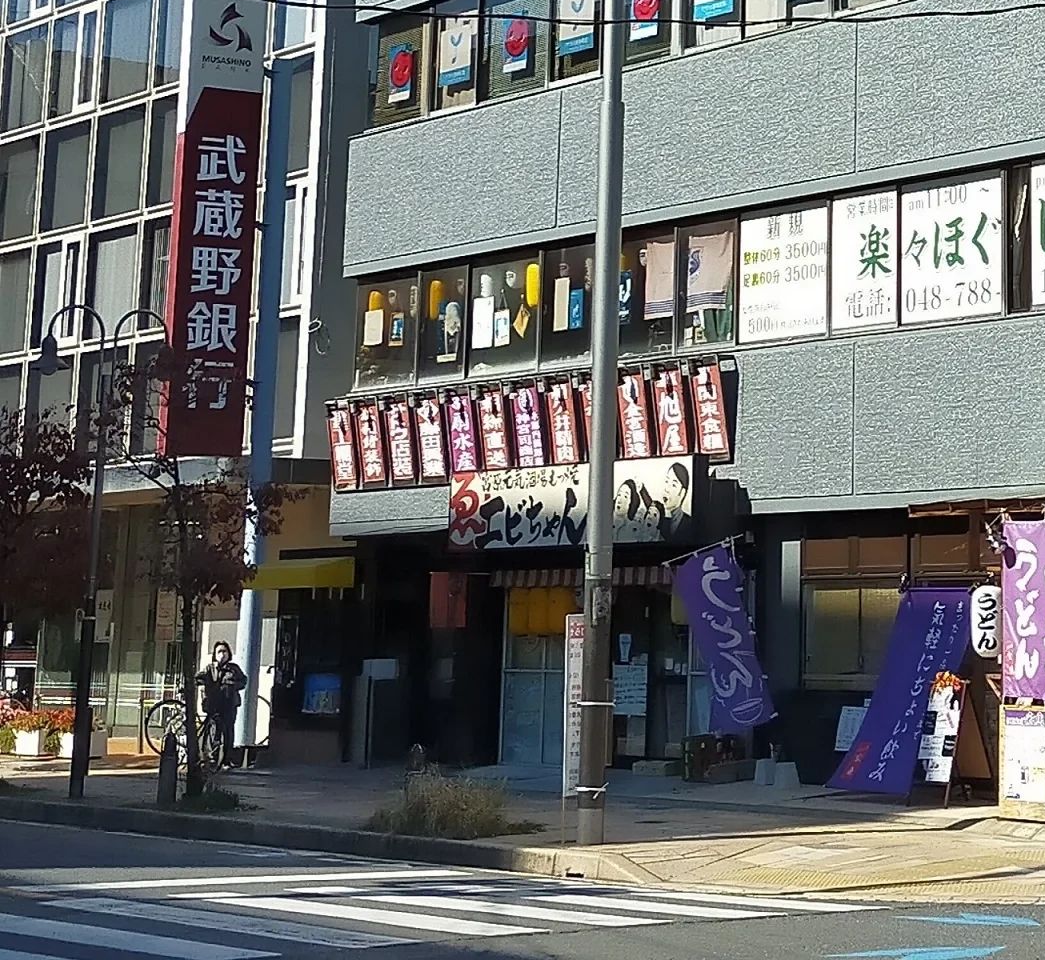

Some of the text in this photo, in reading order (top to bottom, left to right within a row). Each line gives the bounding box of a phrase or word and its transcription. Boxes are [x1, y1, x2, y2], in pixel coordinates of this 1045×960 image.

[202, 55, 252, 67] MUSASHINO
[181, 134, 247, 410] 武蔵野銀行
[978, 593, 998, 651] うどん
[1014, 538, 1040, 681] うどん
